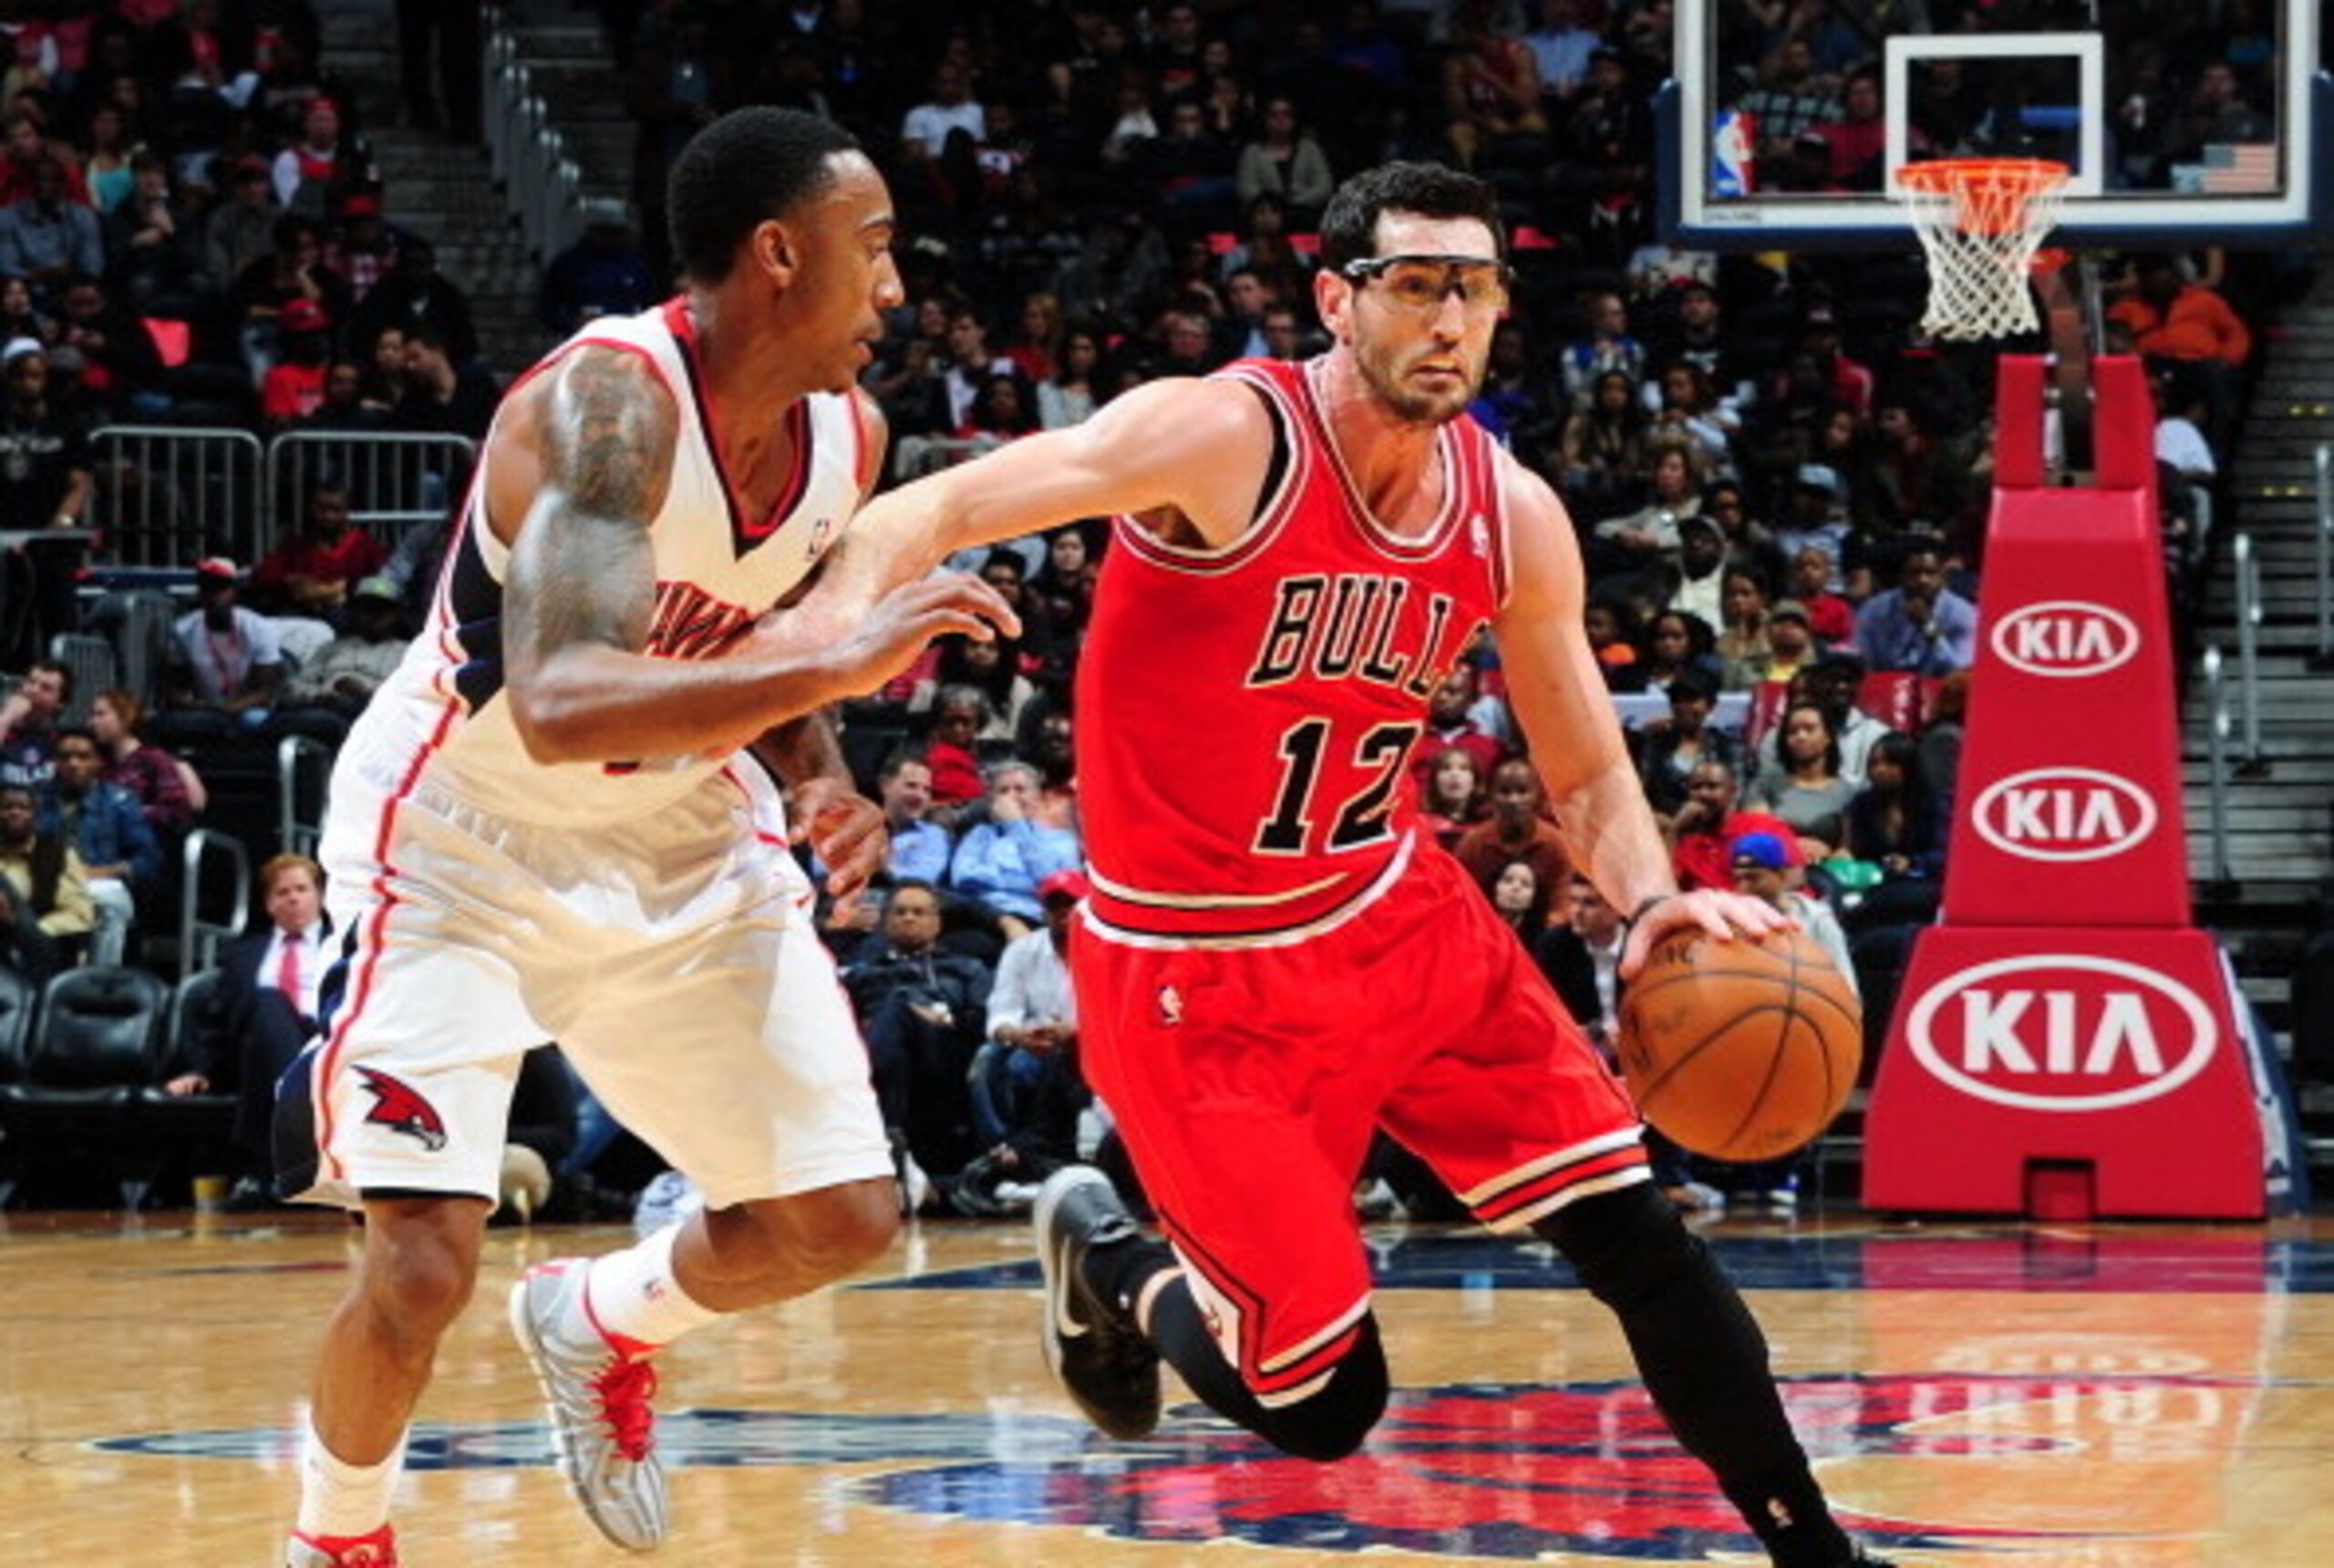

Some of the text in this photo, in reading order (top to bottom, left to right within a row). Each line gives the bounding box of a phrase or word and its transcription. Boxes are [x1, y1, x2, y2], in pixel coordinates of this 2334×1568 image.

[2017, 618, 2114, 661] KIA
[1251, 717, 1423, 854] 12
[2006, 789, 2128, 840] KIA
[1961, 990, 2164, 1076] KIA
